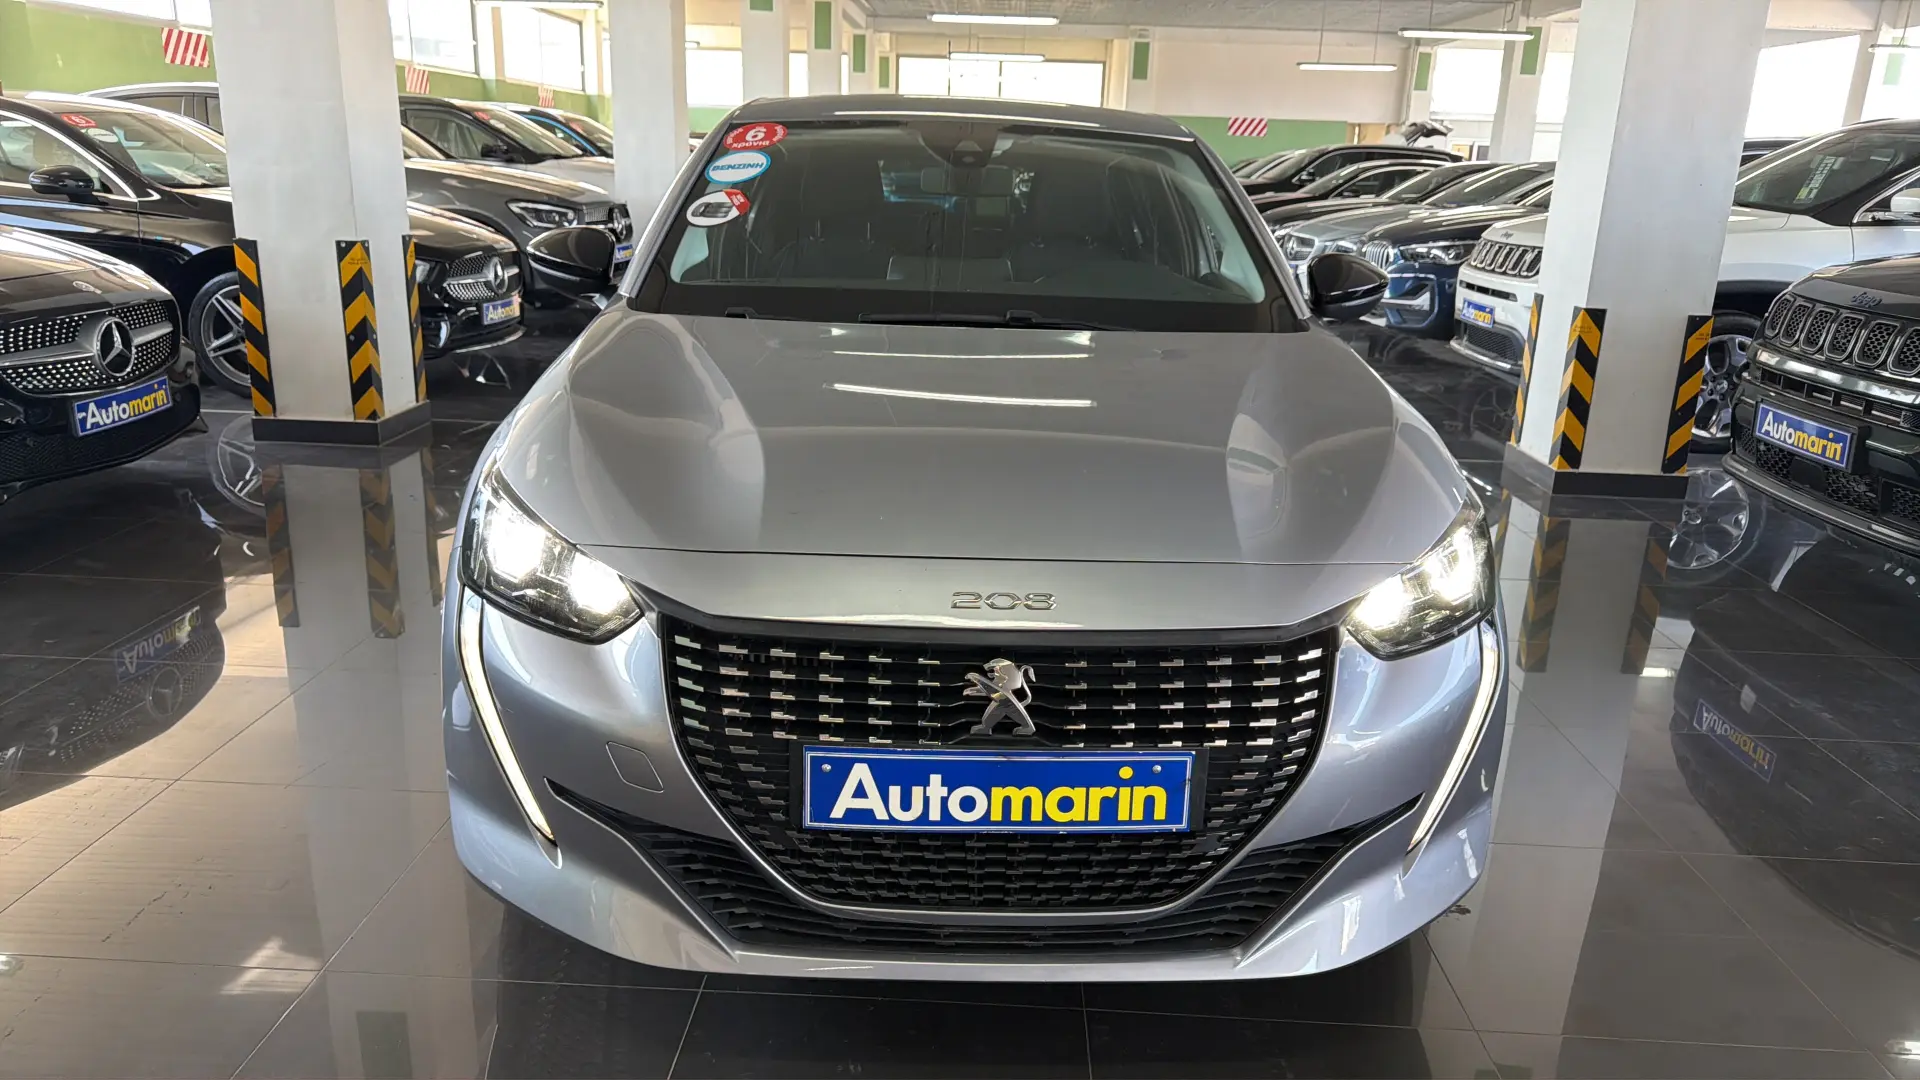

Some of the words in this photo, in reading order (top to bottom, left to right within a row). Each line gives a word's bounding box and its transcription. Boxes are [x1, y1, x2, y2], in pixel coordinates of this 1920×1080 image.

[745, 128, 767, 142] 6
[86, 384, 167, 430] Automarin
[1761, 411, 1843, 461] Automarin
[951, 591, 1057, 611] 208
[829, 762, 1167, 823] Automarin
